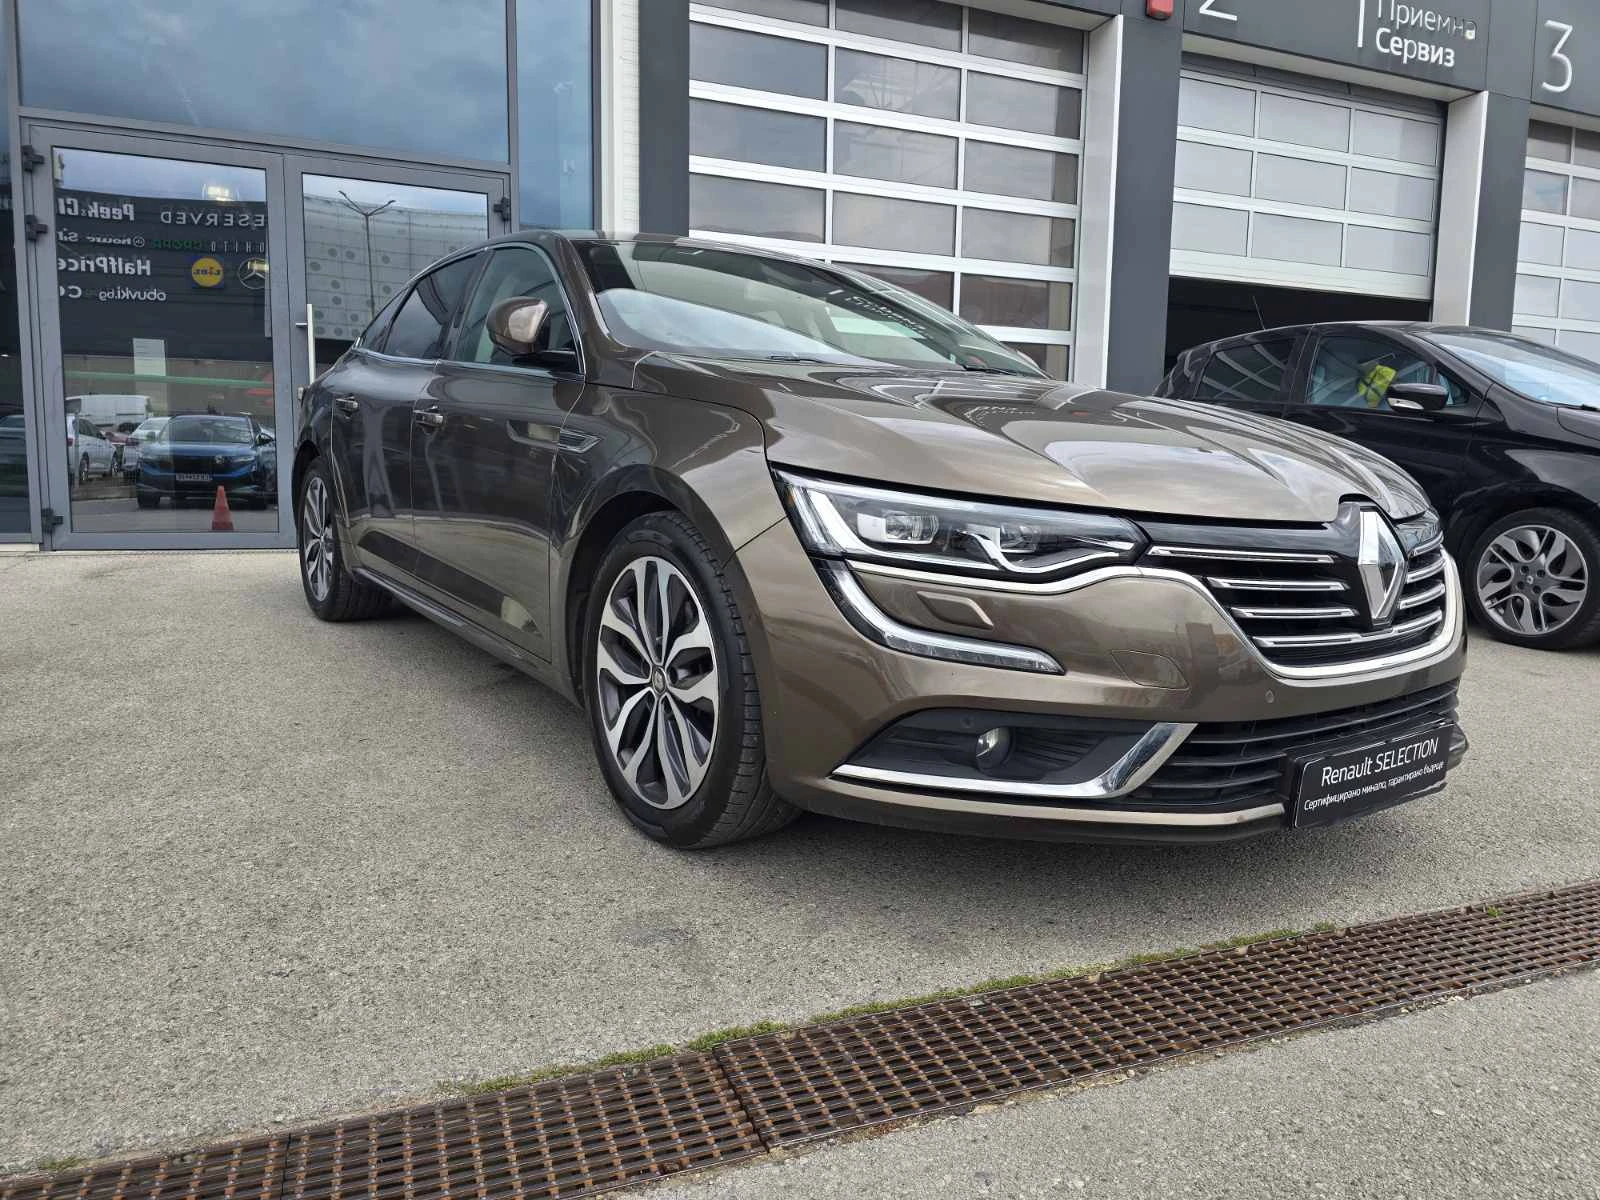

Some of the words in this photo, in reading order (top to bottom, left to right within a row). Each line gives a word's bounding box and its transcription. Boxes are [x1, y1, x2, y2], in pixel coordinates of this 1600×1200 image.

[1376, 27, 1455, 68] Сервиз
[1541, 20, 1573, 93] 3
[1321, 756, 1373, 788] Renault
[1374, 737, 1439, 773] SELECTION
[1304, 786, 1361, 811] Сертифицирано
[1388, 767, 1424, 786] гарантирано
